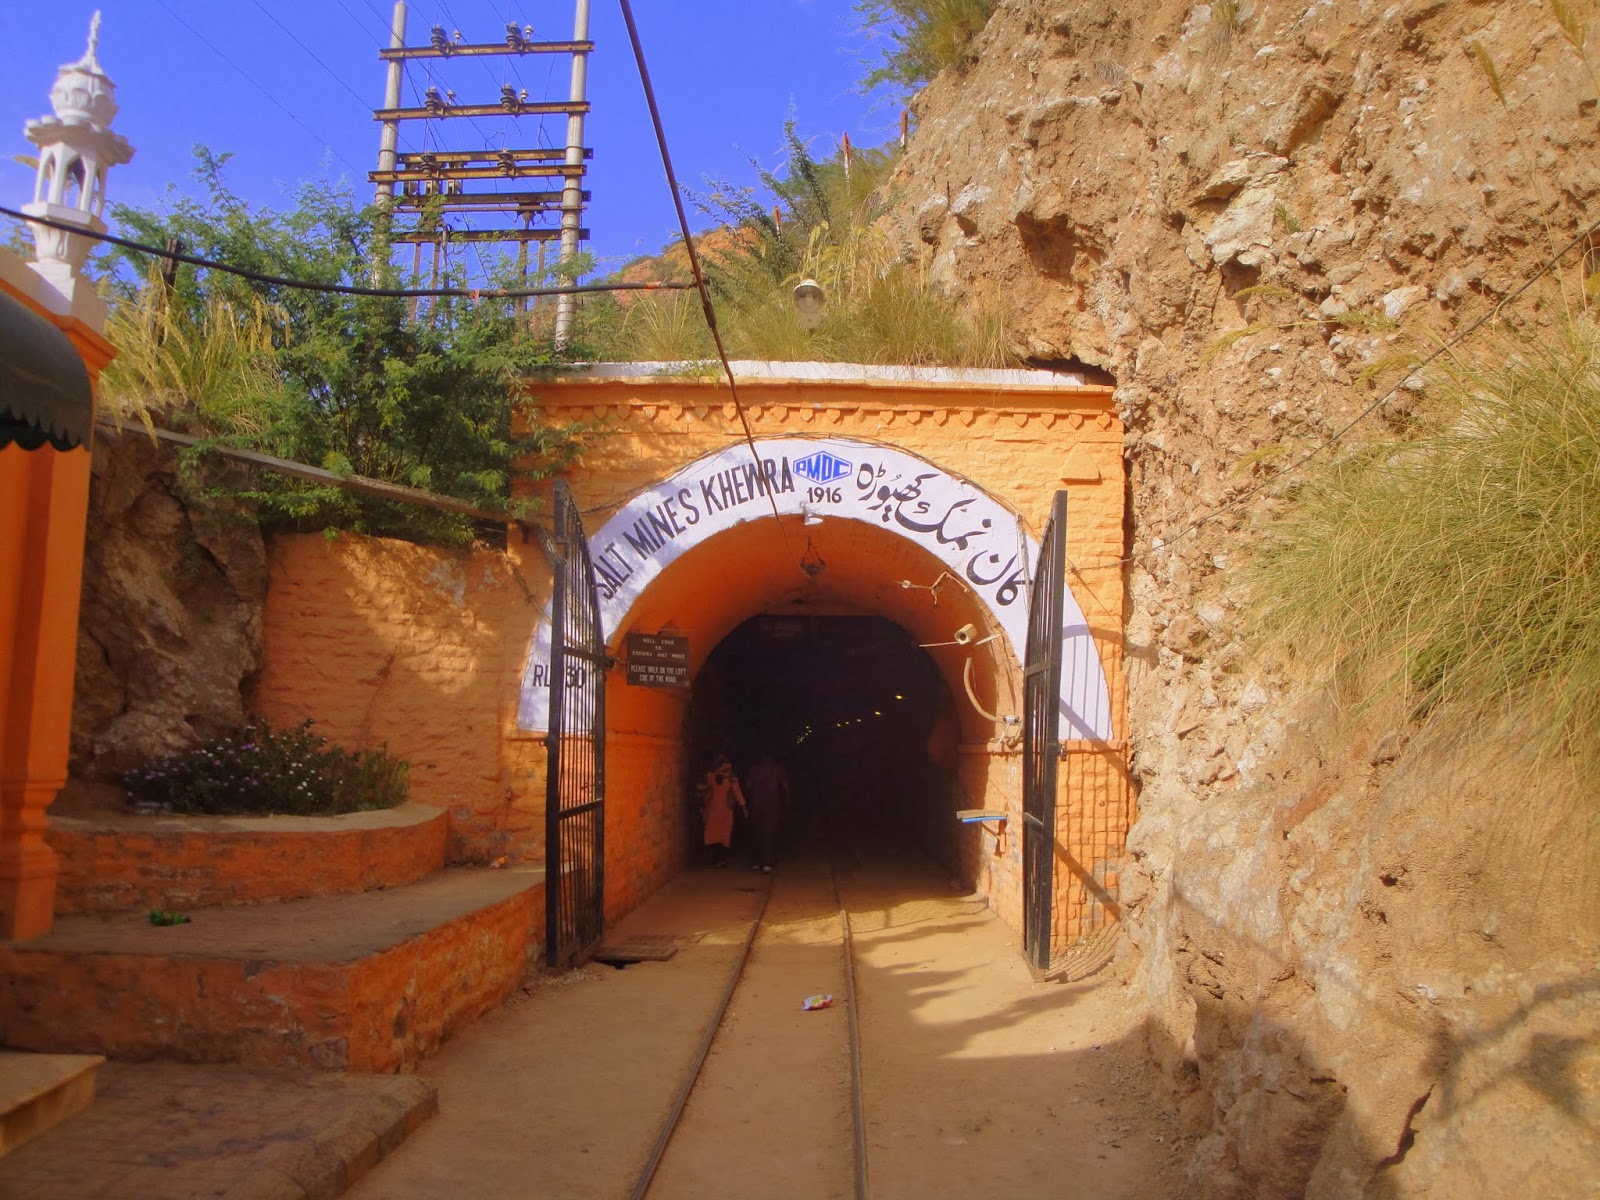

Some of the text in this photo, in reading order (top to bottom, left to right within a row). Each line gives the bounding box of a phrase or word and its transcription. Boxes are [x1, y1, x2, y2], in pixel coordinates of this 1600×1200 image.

[793, 451, 852, 484] PMDC
[806, 486, 842, 504] 1916
[594, 456, 795, 600] SALT MINES KHEWRA
[895, 498, 992, 551] نمک
[630, 664, 646, 673] PLEASE
